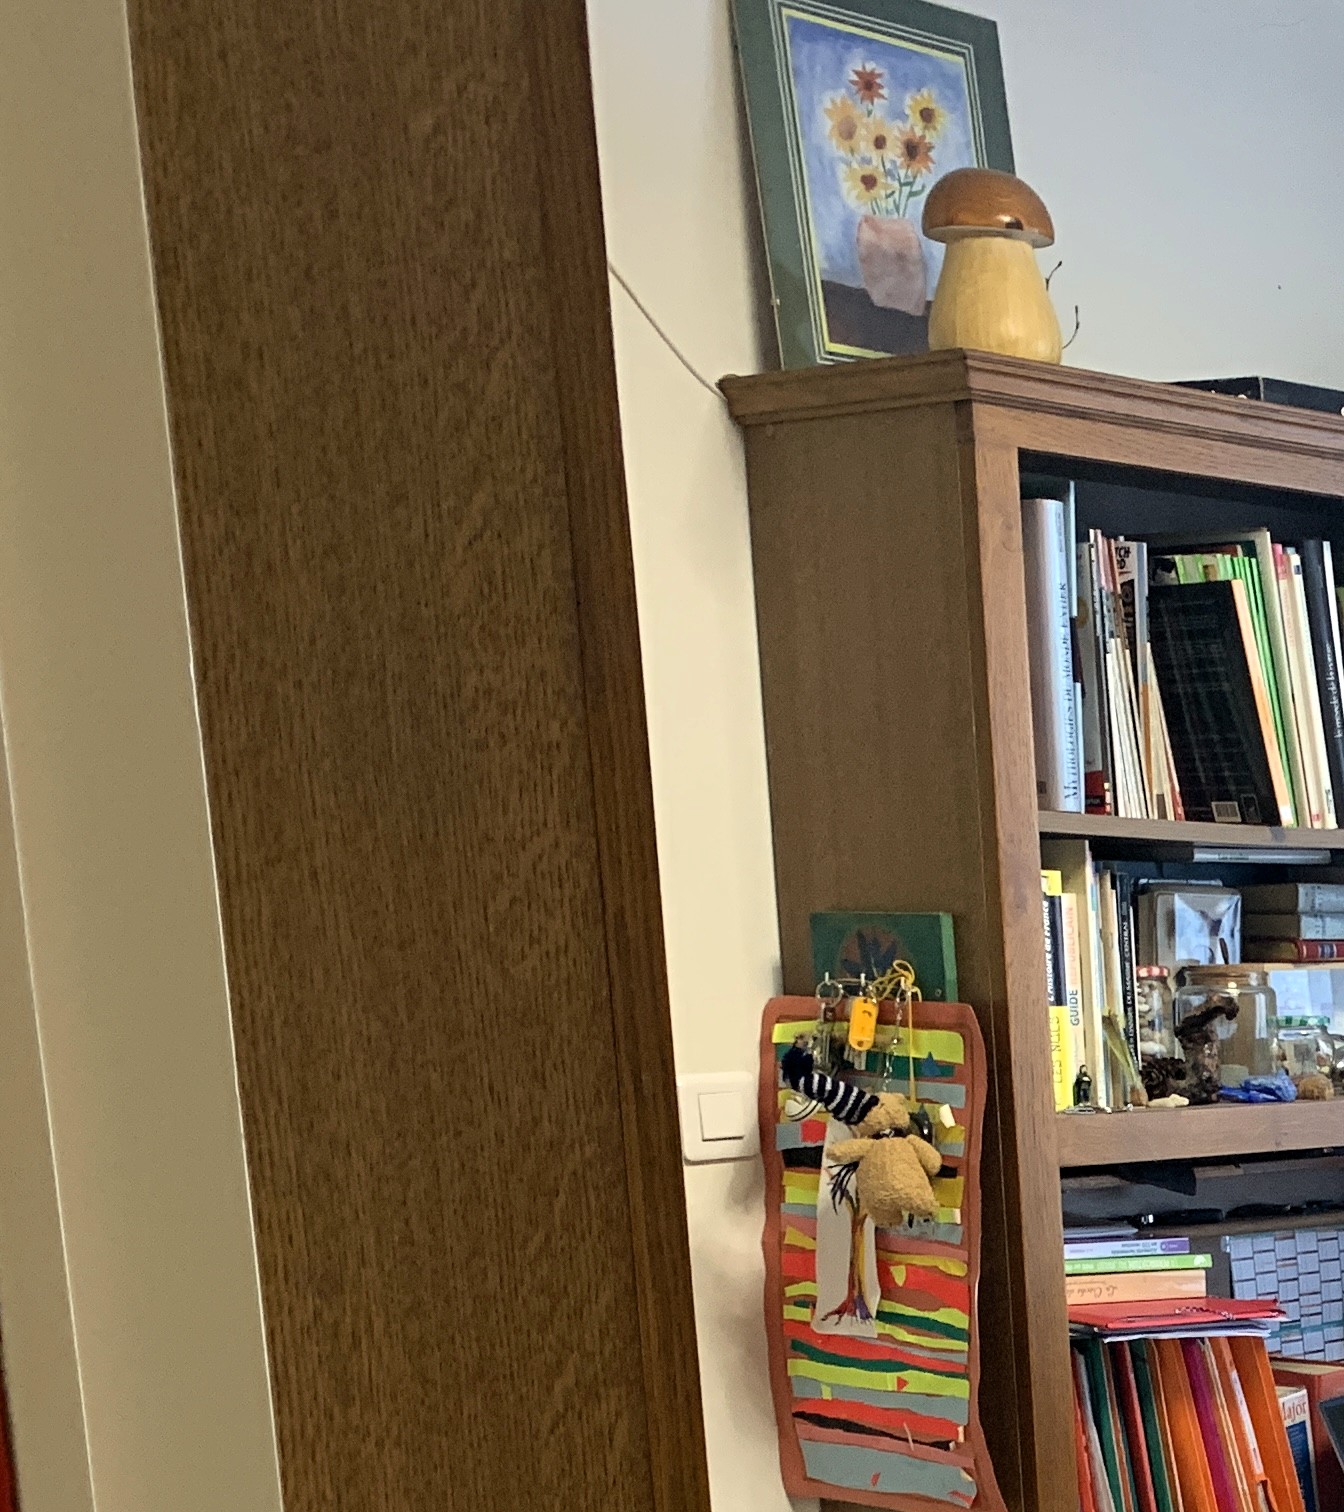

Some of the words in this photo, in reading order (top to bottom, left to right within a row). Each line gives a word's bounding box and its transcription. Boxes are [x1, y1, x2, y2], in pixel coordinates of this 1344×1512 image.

[1061, 633, 1072, 679] MONDE
[1063, 705, 1079, 800] MYTHOLOGIES
[1069, 989, 1080, 1027] GUIDE
